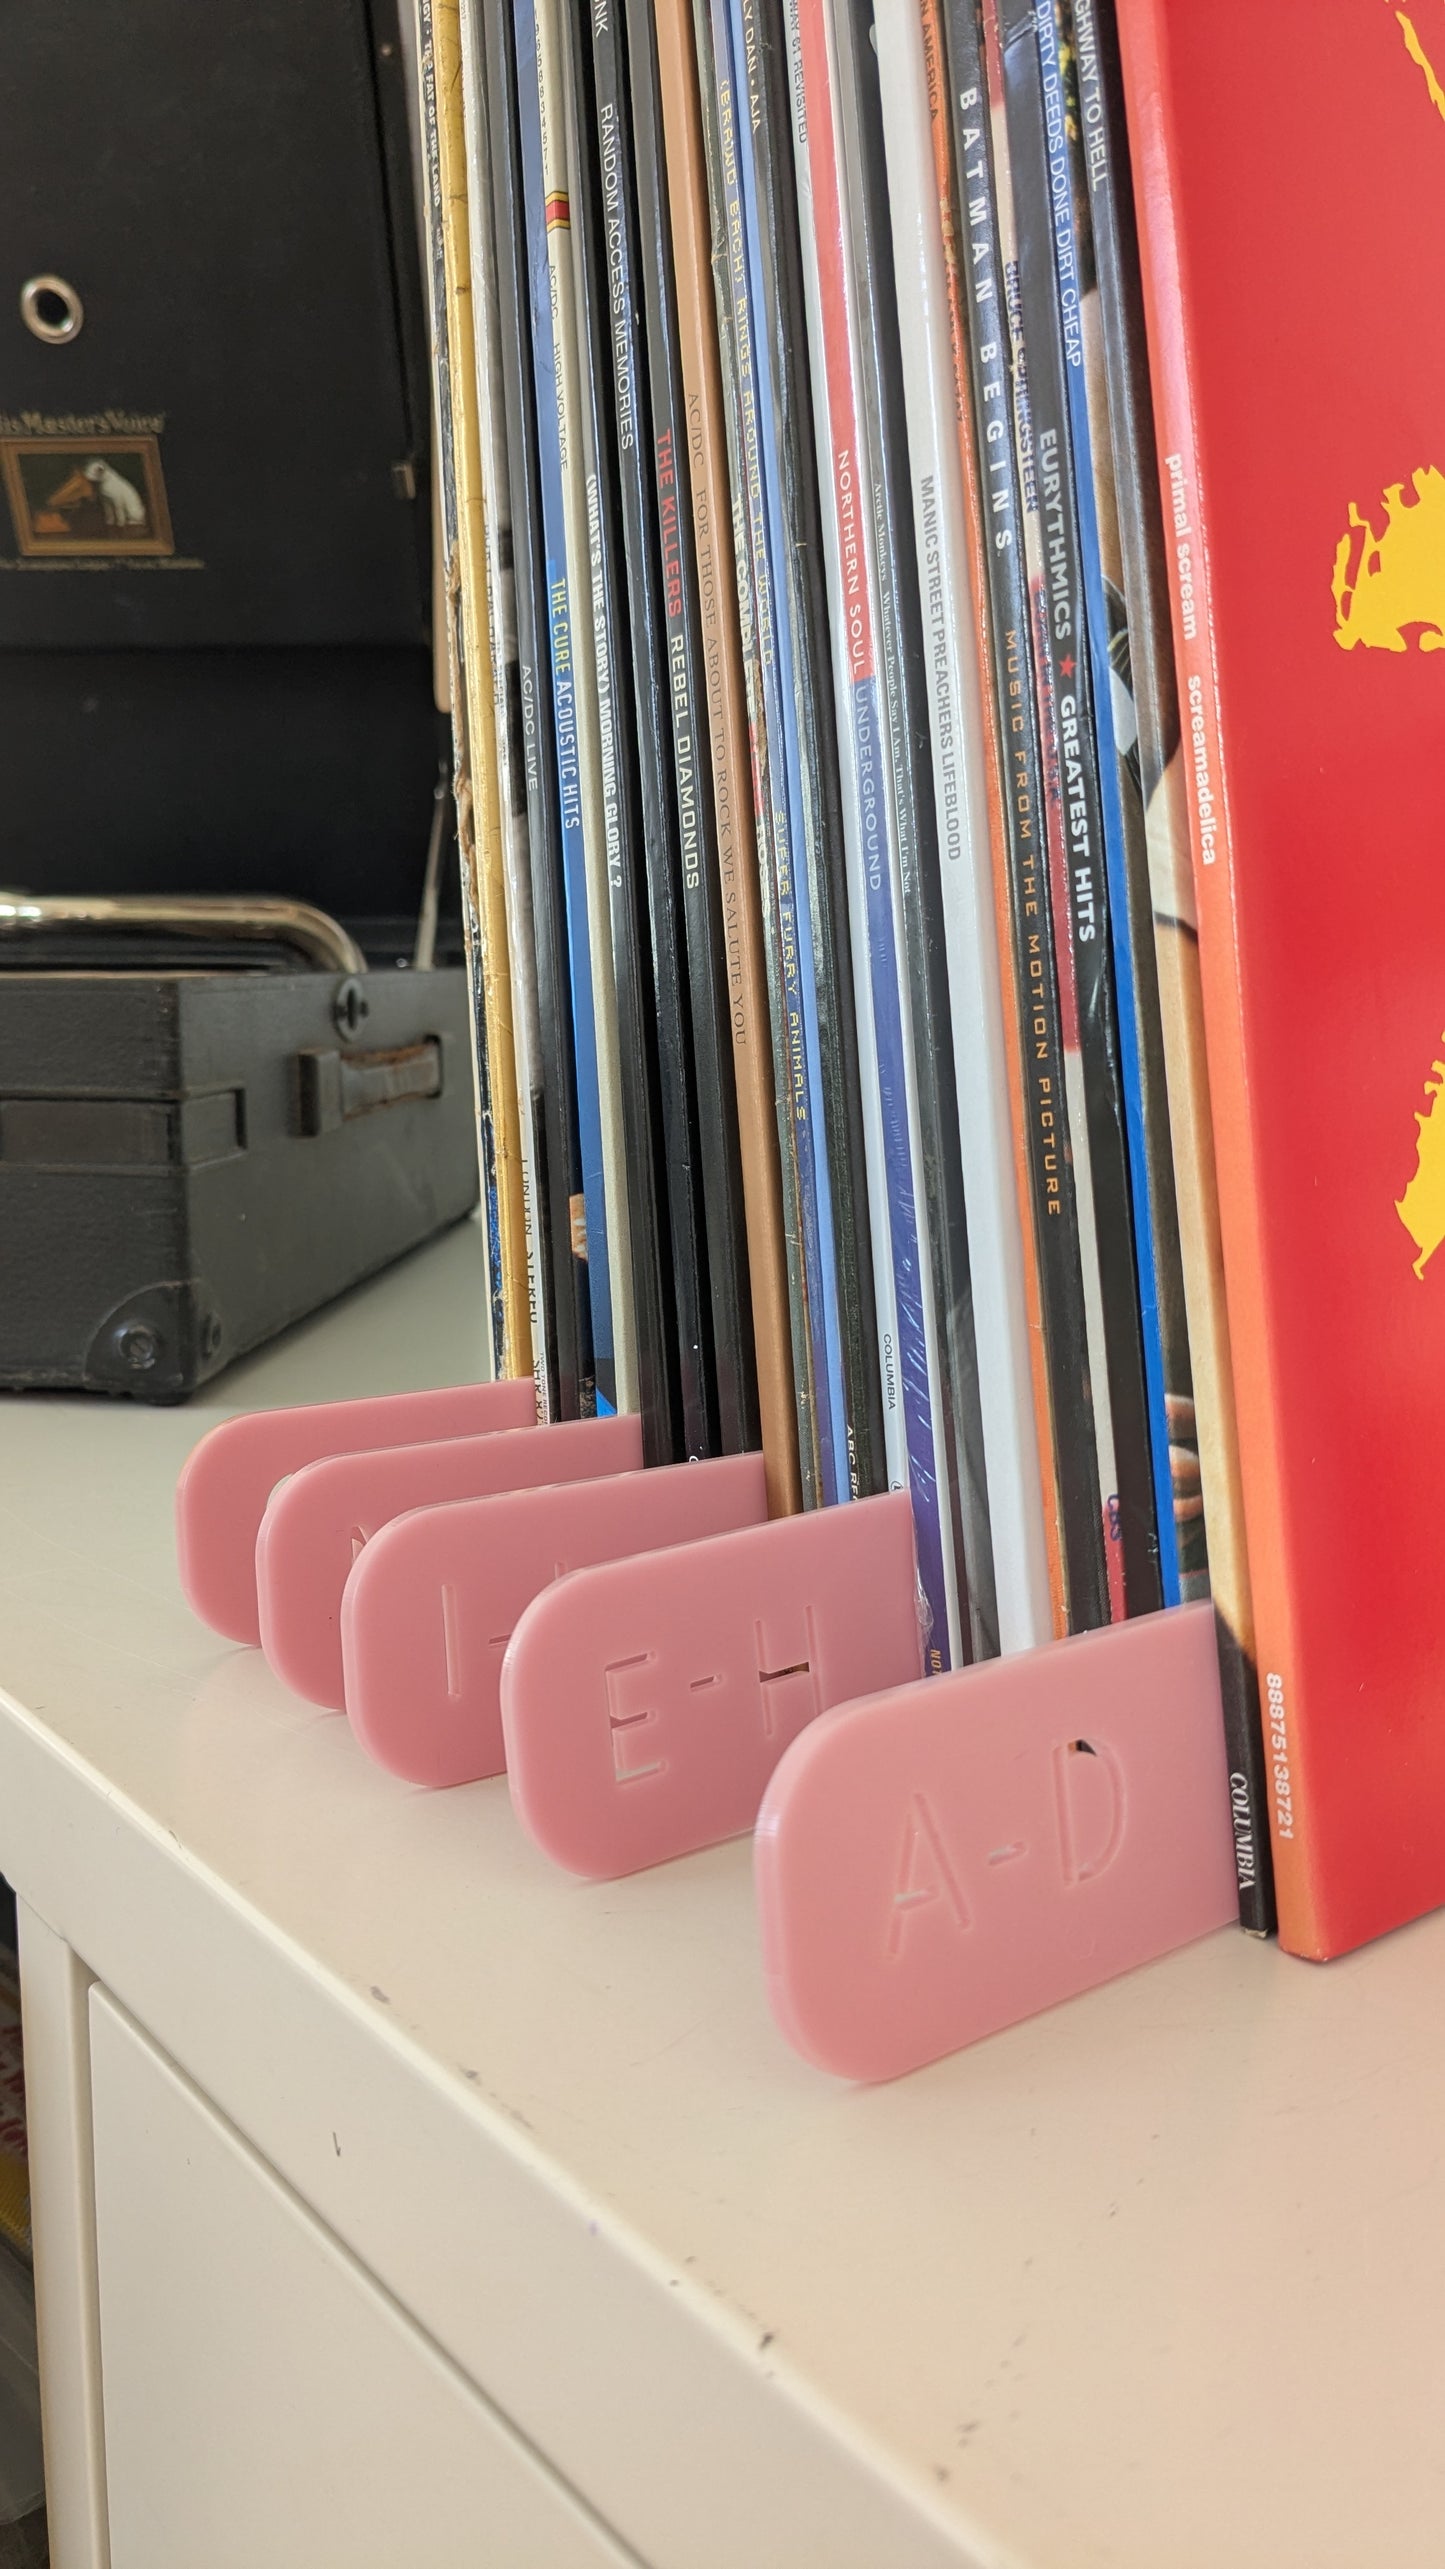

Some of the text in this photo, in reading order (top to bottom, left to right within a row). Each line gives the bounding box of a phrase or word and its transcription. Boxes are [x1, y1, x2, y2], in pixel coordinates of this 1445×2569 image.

[425, 74, 435, 101] FAT
[745, 27, 757, 74] DAN
[922, 24, 938, 119] AMERICA
[428, 106, 437, 125] OF
[749, 94, 762, 135] AJA
[793, 60, 808, 143] REVISITED
[1084, 86, 1102, 124] TO
[431, 163, 442, 207] LAND
[1036, 1, 1082, 368] DIRTY DEEDS DONE DIRT CHEAP
[1088, 128, 1109, 192] HELL
[594, 0, 634, 451] NK RANDOM ACCESS MEMORIES
[735, 296, 752, 377] RINGS
[742, 390, 760, 500] AROUND
[585, 473, 602, 566] (WHAT'S
[732, 494, 747, 556] THE
[753, 511, 765, 560] THE
[873, 483, 884, 524] Arctic
[590, 569, 606, 612] THE
[876, 525, 888, 583] Monkeys
[593, 615, 611, 693] STORY)
[657, 428, 700, 890] THE KILLERS REBEL DIAMONDS
[757, 573, 773, 667] WORLD
[883, 591, 895, 654] Whatever
[960, 87, 1061, 1216] BATMAN BEGINS MUSIC FROM THE MOTION PICTURE
[1164, 453, 1218, 866] primal scream screamadelica
[550, 577, 580, 829] THE CURE ACOUSTIC HITS
[837, 449, 882, 891] NORTHERN SOUL UNDERGROUND
[887, 656, 897, 696] People
[890, 697, 899, 722] Say
[919, 475, 962, 862] MANIC STREET PREACHERS LIFEBLOOD
[1039, 427, 1071, 641] EURYTHMICS
[1060, 694, 1090, 858] GREATEST
[1075, 866, 1096, 943] HITS
[522, 665, 538, 792] AC/DC LIVE
[598, 697, 618, 798] MORNING
[688, 392, 747, 1046] AC/DC FOR THOSE ABOUT TO ROCK WE SALUTE YOU
[894, 766, 906, 806] That's
[898, 807, 909, 844] What
[774, 810, 792, 897] SUPER
[902, 871, 913, 895] Not
[781, 910, 798, 996] FURRY
[788, 1011, 806, 1121] ANIMALS
[883, 1333, 896, 1411] COLUMBIA
[846, 1424, 859, 1501] ABC RE
[1266, 1671, 1294, 1840] 88875138721
[1229, 1772, 1256, 1890] COLUMBIA
